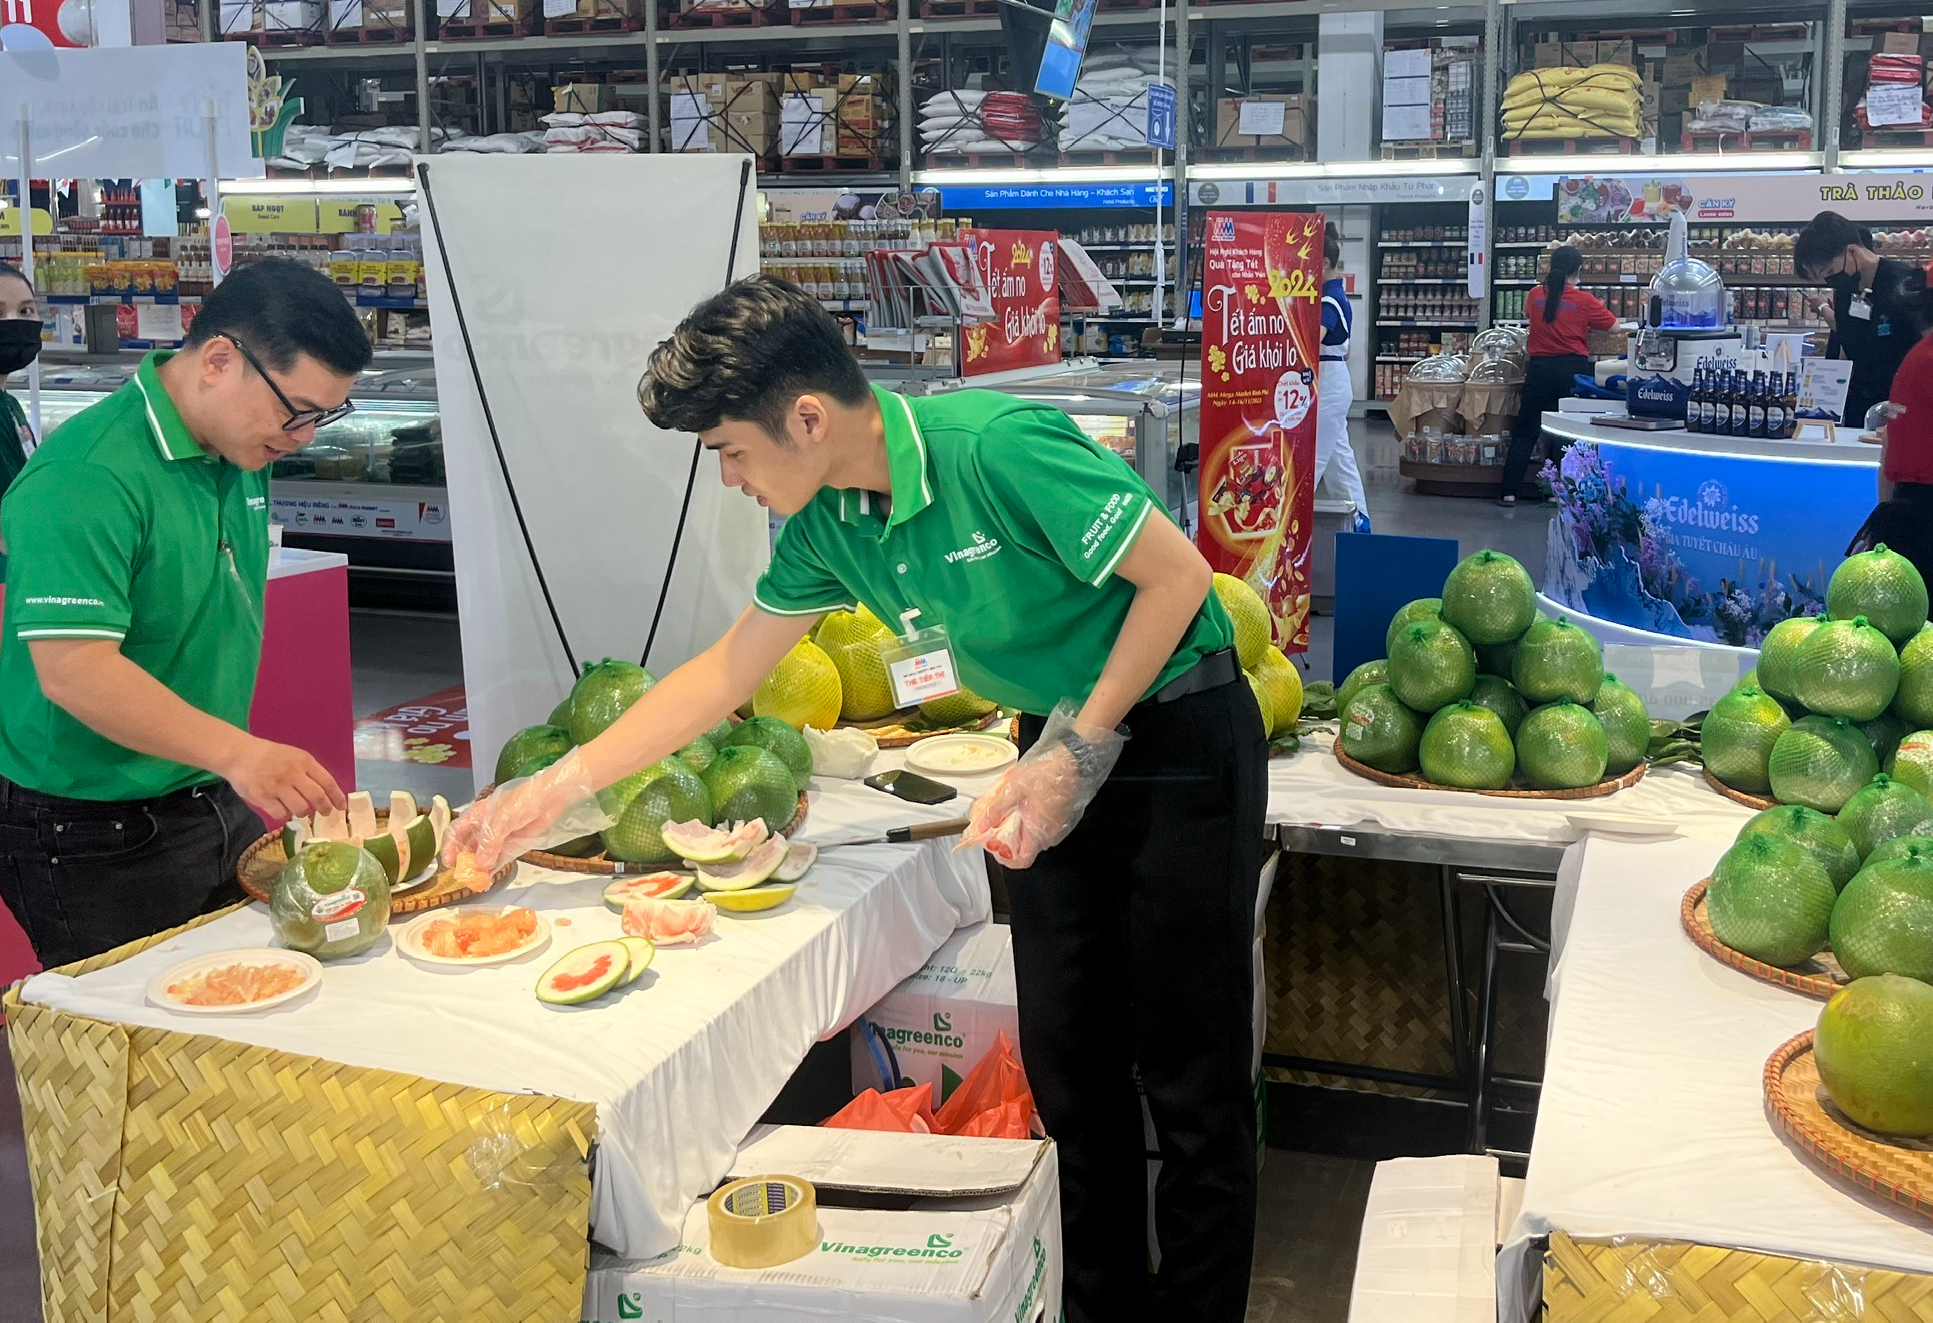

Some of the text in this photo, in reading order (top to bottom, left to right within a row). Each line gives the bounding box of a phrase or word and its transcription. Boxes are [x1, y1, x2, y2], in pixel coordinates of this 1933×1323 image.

[984, 190, 999, 198] Sản
[1020, 189, 1039, 198] Dành
[1039, 189, 1054, 197] Cho
[1055, 189, 1070, 197] Nhà
[1070, 189, 1089, 199] Hàng
[1096, 188, 1119, 196] Khách
[1120, 188, 1135, 197] Sạn
[1820, 181, 1924, 201] TRÀ THẢO
[1720, 197, 1736, 208] KÝ
[1232, 248, 1248, 256] Khách
[1209, 257, 1259, 271] Quà Tặng Tết
[1015, 275, 1026, 297] no
[1268, 269, 1318, 305] 2024
[1207, 284, 1285, 347] Tết ấm no
[1232, 338, 1298, 375] Giá khỏi lo
[1696, 355, 1737, 370] Edelweiss
[1637, 388, 1674, 402] Edelweiss
[1081, 493, 1121, 546] FRUIT & FOOD
[1665, 495, 1759, 534] Edelweiss
[1083, 539, 1100, 559] Good
[1096, 521, 1114, 544] food,
[1681, 535, 1712, 552] TUYẾT
[1712, 541, 1741, 557] CHÂU
[1742, 545, 1758, 560] ÂU
[953, 976, 969, 985] UP
[969, 967, 993, 979] 22kg
[821, 1241, 963, 1258] Vinagreenco
